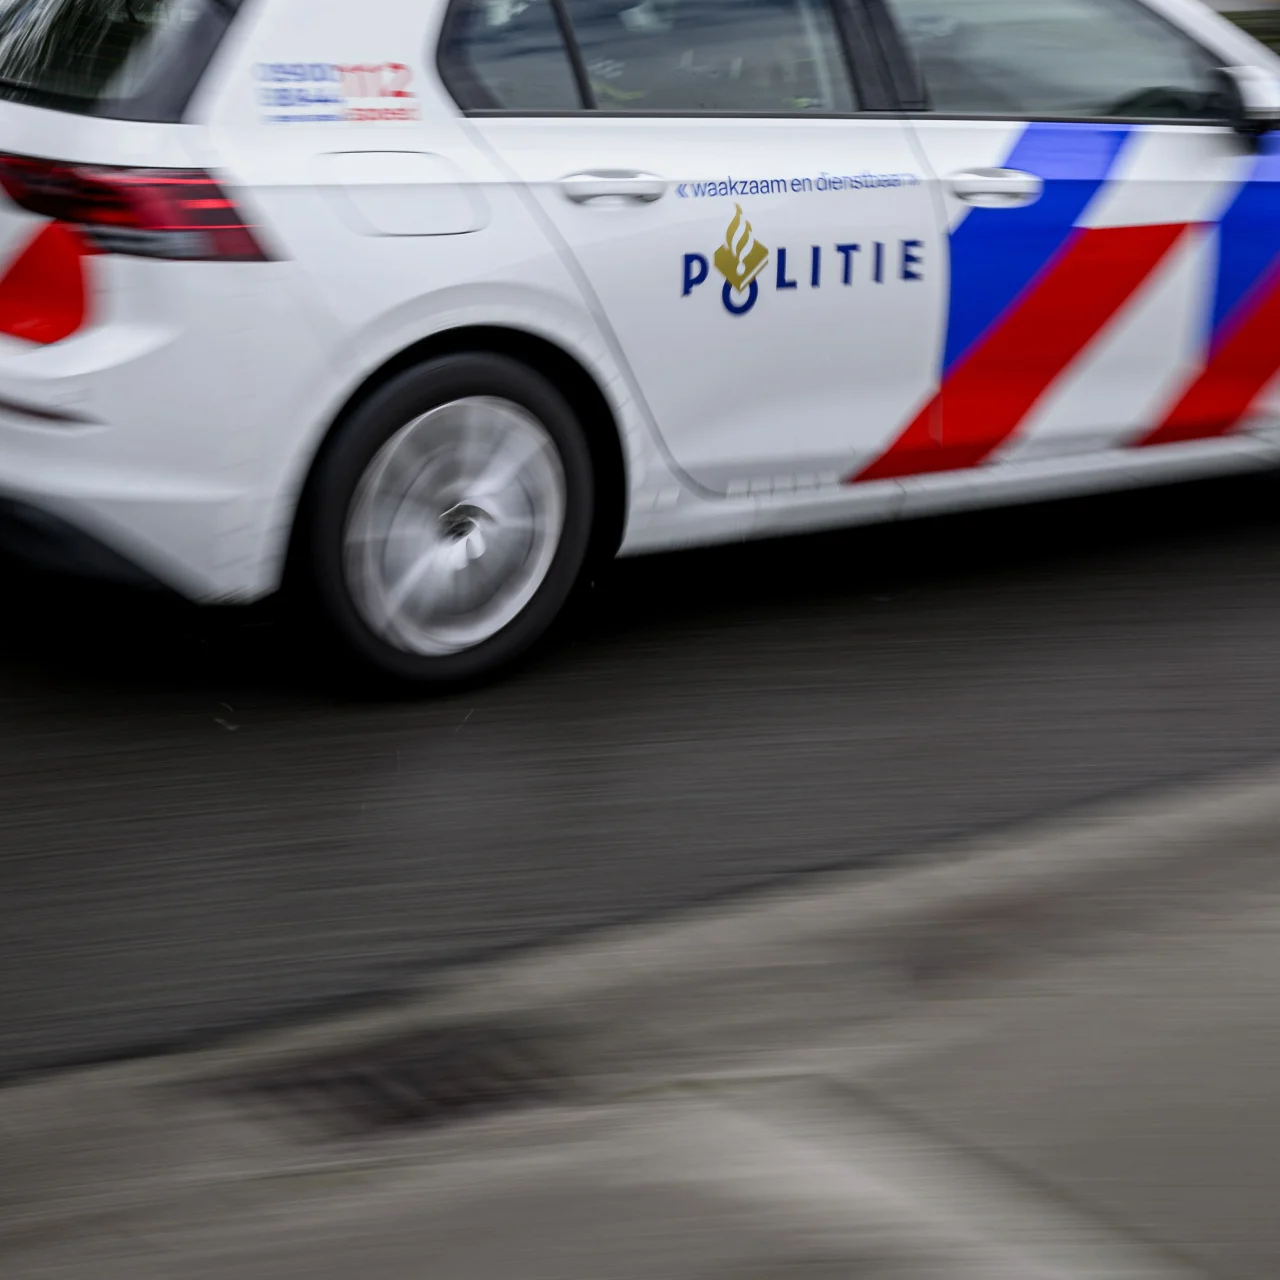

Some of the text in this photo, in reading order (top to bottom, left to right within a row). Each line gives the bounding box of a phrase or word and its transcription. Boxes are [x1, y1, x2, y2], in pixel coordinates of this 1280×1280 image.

[692, 176, 788, 197] waakzaam
[791, 177, 813, 193] en
[680, 238, 925, 315] POLITIE
